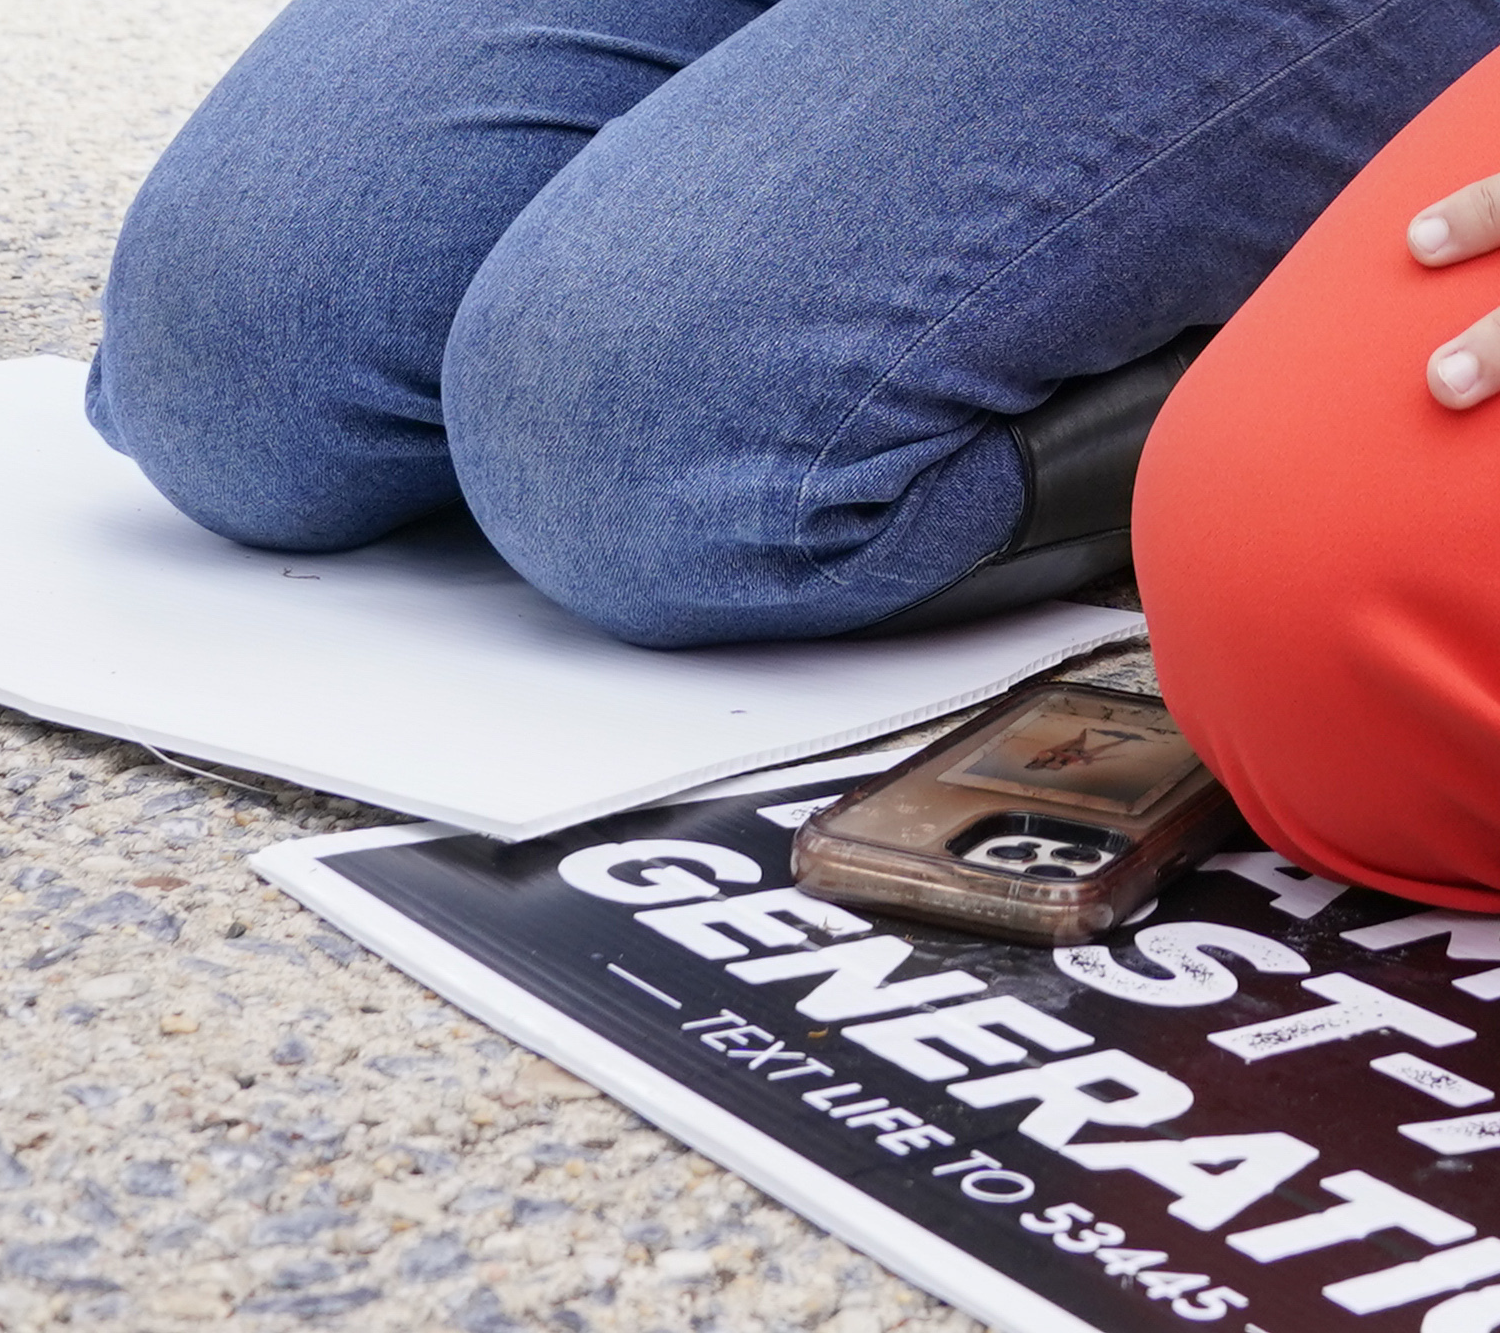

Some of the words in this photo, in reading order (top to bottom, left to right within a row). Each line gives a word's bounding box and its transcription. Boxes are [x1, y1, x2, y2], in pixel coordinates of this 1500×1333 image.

[681, 1008, 834, 1081] TEXT
[802, 1082, 955, 1156] LIFE
[933, 1149, 1035, 1203] TO
[1020, 1202, 1249, 1322] 53445
